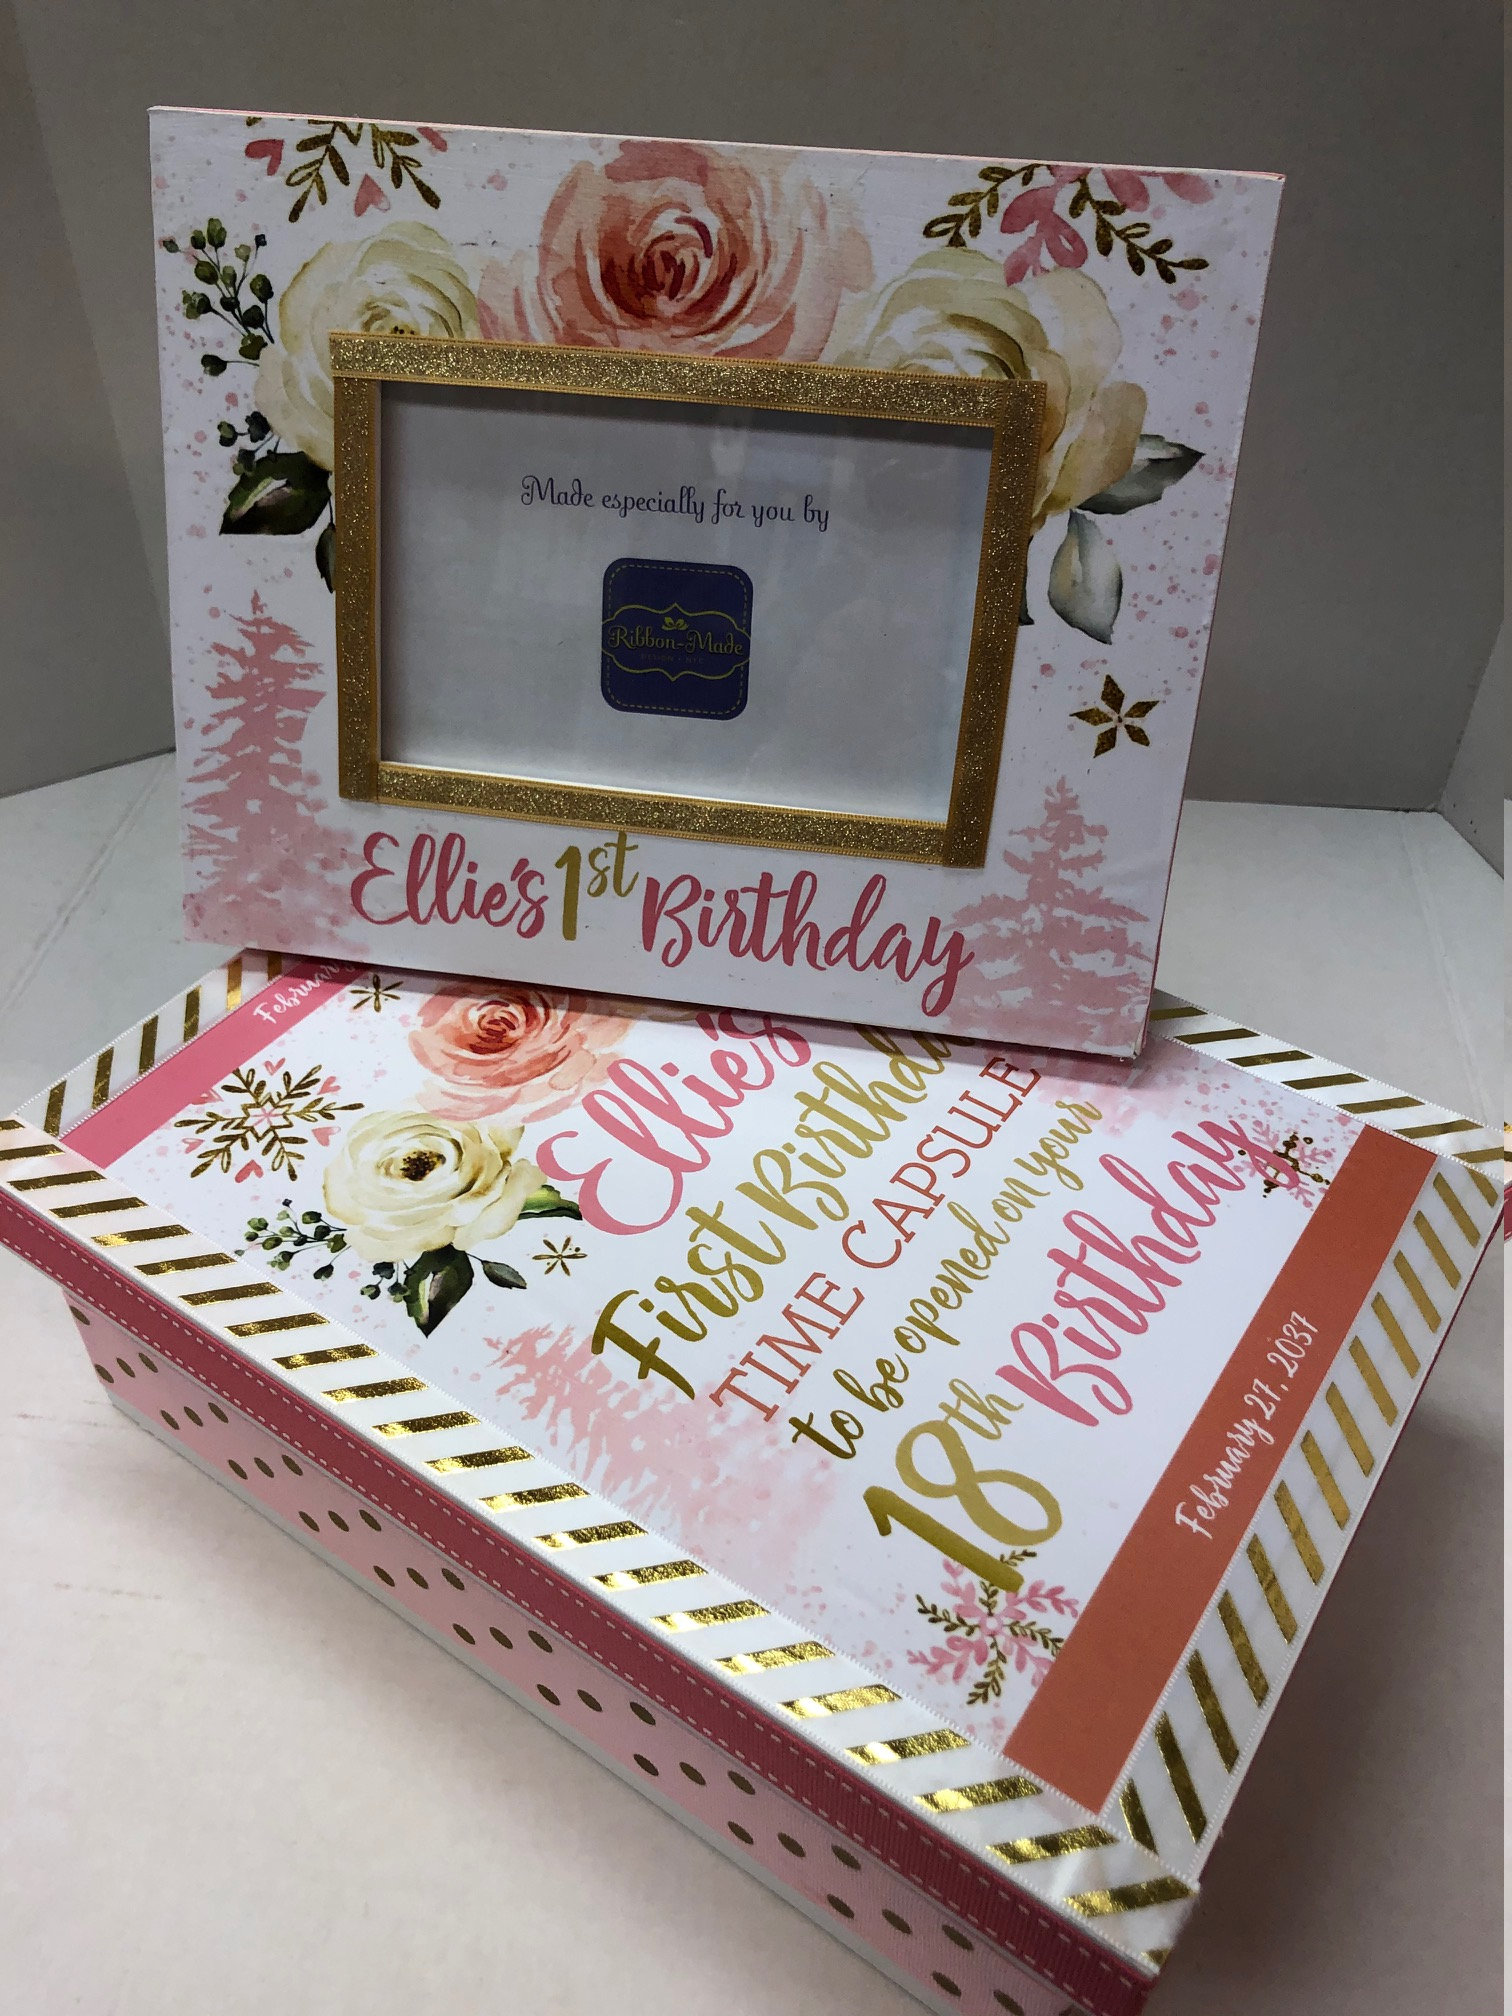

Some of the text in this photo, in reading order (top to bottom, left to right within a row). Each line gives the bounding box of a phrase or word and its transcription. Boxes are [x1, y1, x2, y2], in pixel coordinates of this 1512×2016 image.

[521, 475, 829, 532] Made especially for you by
[608, 625, 743, 655] Ribbon-Made
[253, 961, 356, 1024] Februar
[351, 830, 974, 1018] Ellie's 1st Birthday
[536, 1008, 811, 1235] Ellie's
[592, 1027, 976, 1399] First Birthda
[710, 1056, 1041, 1422] TIME CAPSULE
[788, 1100, 1103, 1460] to be opened on your
[863, 1120, 1300, 1592] 18th Birthday
[1174, 1311, 1319, 1540] February 27, 2037
